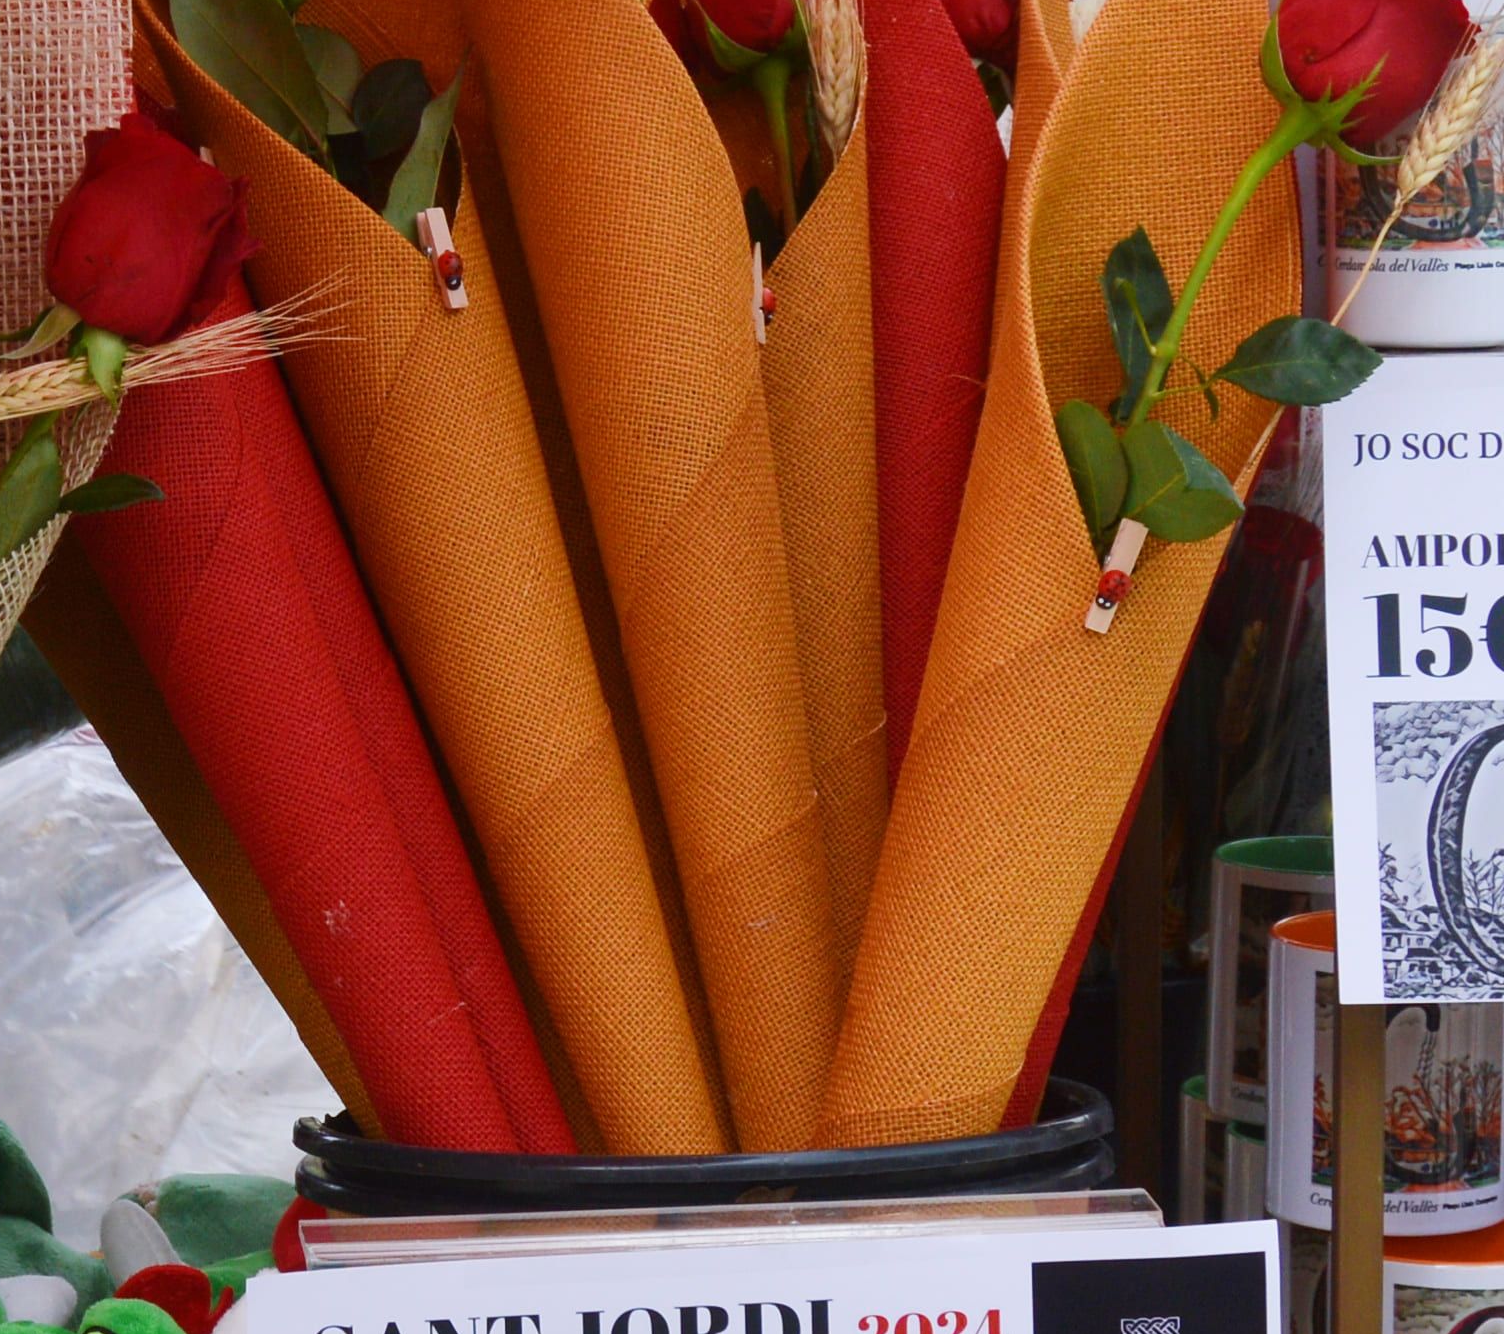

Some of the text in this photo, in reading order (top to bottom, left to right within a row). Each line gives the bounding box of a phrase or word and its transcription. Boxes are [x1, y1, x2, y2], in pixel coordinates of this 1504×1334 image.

[1389, 258, 1409, 273] del
[1410, 258, 1449, 273] Vallès
[1353, 433, 1392, 468] JO
[1401, 433, 1470, 461] SOC
[1403, 1200, 1438, 1213] Vallès
